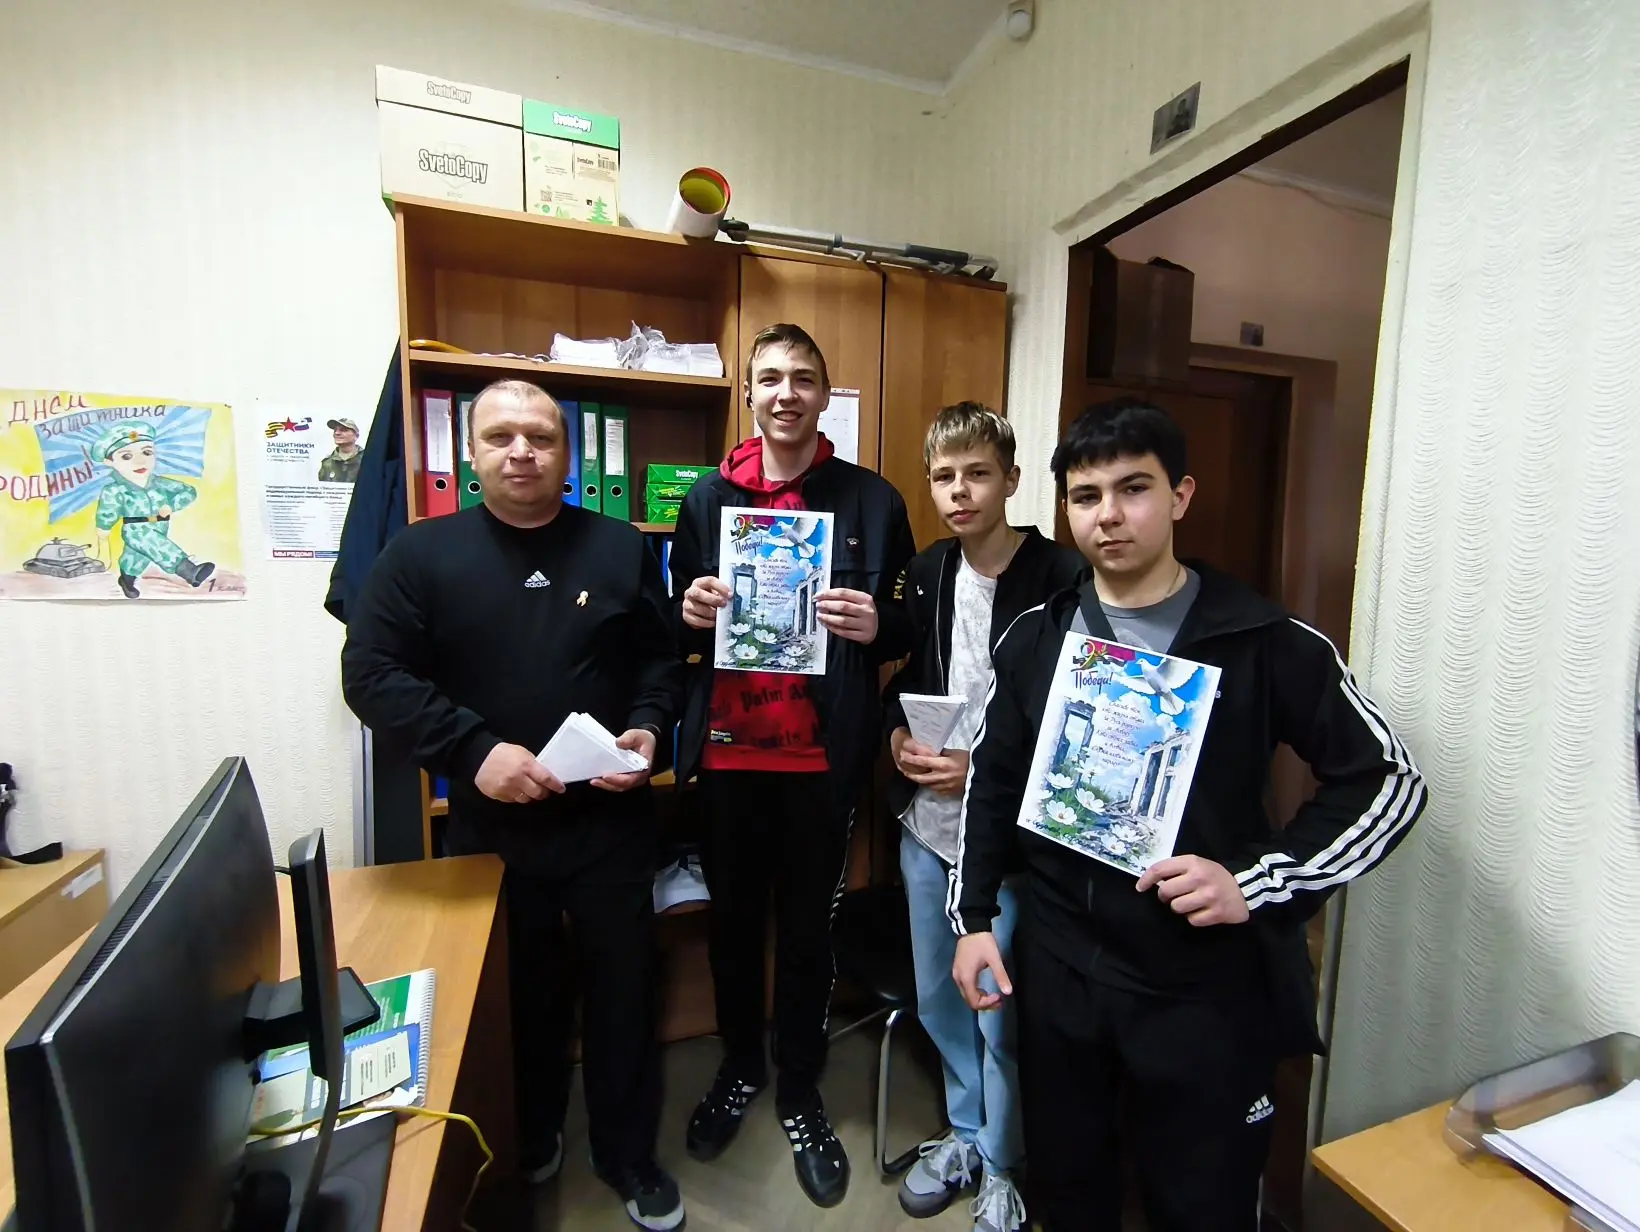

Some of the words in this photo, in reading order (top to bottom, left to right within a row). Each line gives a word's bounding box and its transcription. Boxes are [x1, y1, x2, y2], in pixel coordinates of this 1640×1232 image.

[427, 80, 472, 104] SvetoCopy
[553, 110, 593, 133] SvetoCopy
[418, 148, 489, 184] SvetoCopy
[266, 441, 315, 449] ЗАЩИТНИКИ
[266, 447, 310, 455] ОТЕЧЕСТВА
[524, 580, 551, 588] adidas
[1070, 669, 1114, 695] Победа!
